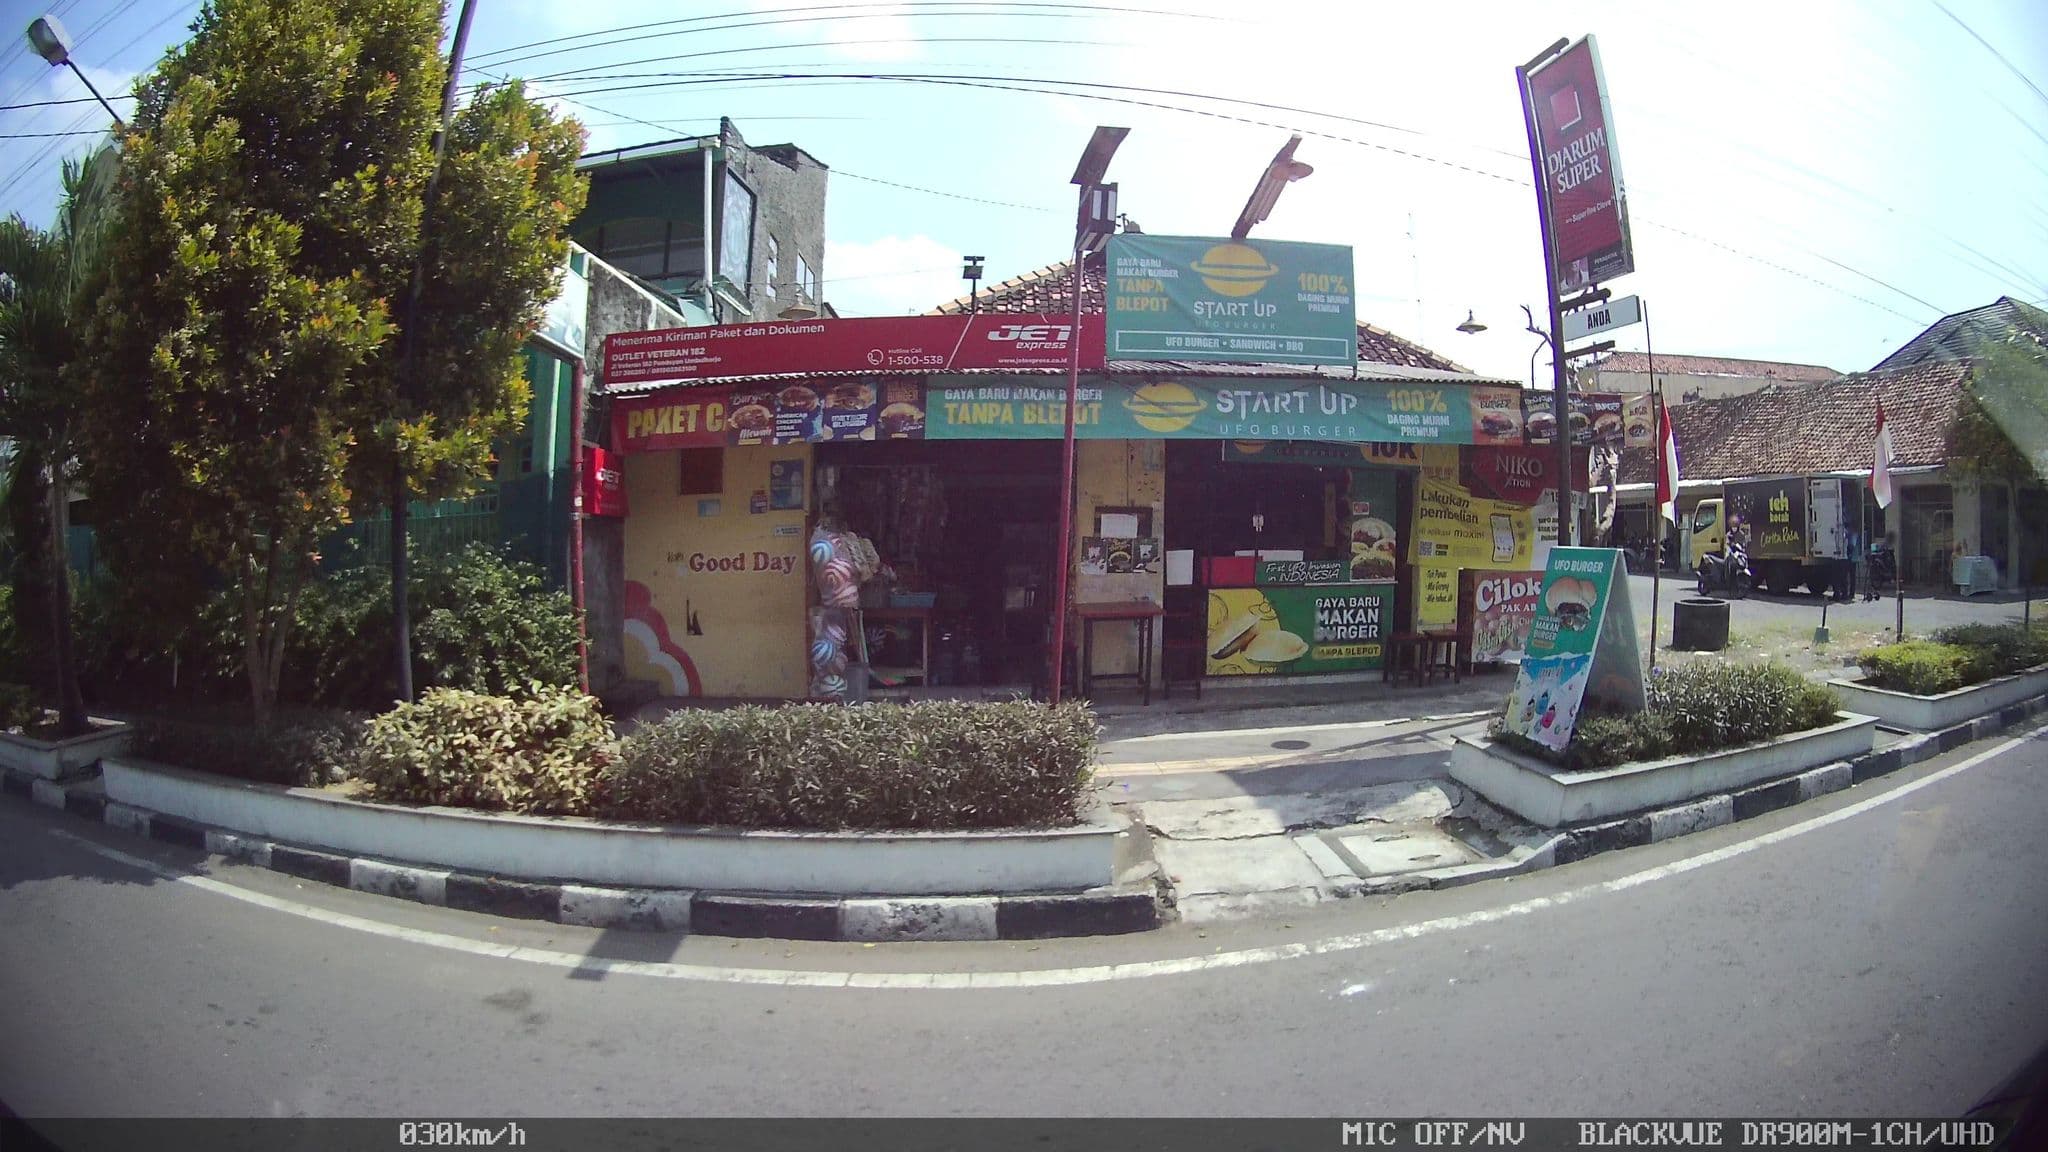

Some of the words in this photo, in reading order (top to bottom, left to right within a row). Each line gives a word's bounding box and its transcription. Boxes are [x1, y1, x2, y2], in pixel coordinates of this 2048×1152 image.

[1548, 128, 1605, 174] DJARUM
[1557, 154, 1602, 193] SUPER
[1117, 258, 1139, 267] GAYA
[1140, 259, 1161, 268] BARU
[1117, 268, 1147, 277] MAKAN
[1148, 269, 1179, 279] BURGER
[1117, 279, 1164, 293] TANPA
[1298, 272, 1348, 294] 100%
[1116, 297, 1169, 312] BLEPOT
[1297, 293, 1325, 303] DAGING
[1193, 301, 1248, 319] START
[1308, 303, 1340, 314] PREMIUM
[1587, 309, 1611, 330] ANDA
[612, 334, 662, 347] Menerima
[666, 331, 707, 343] Kiriman
[710, 329, 741, 339] Paket
[744, 327, 765, 337] dan
[769, 324, 825, 335] Dokumen
[1016, 341, 1067, 350] express
[1166, 337, 1183, 347] UFO
[1185, 337, 1220, 348] BURGER
[1230, 339, 1276, 350] SANDWICH
[1286, 341, 1304, 352] BBQ
[612, 351, 645, 361] OUTLET
[647, 348, 689, 358] VETERAN
[888, 355, 944, 366] 1-500-538
[945, 388, 974, 400] GAYA
[979, 388, 1009, 400] BARU
[1013, 388, 1055, 400] MAKAN
[1059, 388, 1102, 400] BRGER
[1387, 390, 1447, 412] 100%
[1216, 389, 1309, 421] START
[1320, 385, 1358, 415] UP
[628, 403, 700, 439] PAKET
[706, 402, 726, 432] C
[944, 403, 1014, 425] TANPA
[1024, 403, 1102, 425] BLEOT
[1387, 414, 1420, 425] DAGING
[1422, 414, 1450, 426] MURNI
[1219, 424, 1260, 435] UFO
[1271, 425, 1357, 436] BURGER
[1401, 426, 1439, 437] PREMIUM
[1496, 455, 1543, 478] NIKO
[1421, 489, 1469, 508] Lakukan
[1420, 507, 1479, 524] pembelian
[689, 552, 746, 572] Good
[752, 551, 797, 574] Day
[1554, 559, 1570, 571] UFO
[1570, 560, 1604, 573] BURGER
[1279, 568, 1340, 582] INDONESIA
[1315, 597, 1346, 608] GAYA
[1349, 596, 1380, 607] BARU
[1475, 577, 1541, 612] Cilok
[1501, 604, 1521, 613] PAK
[1315, 608, 1379, 625] MAKAN
[1536, 621, 1559, 633] MAKAN
